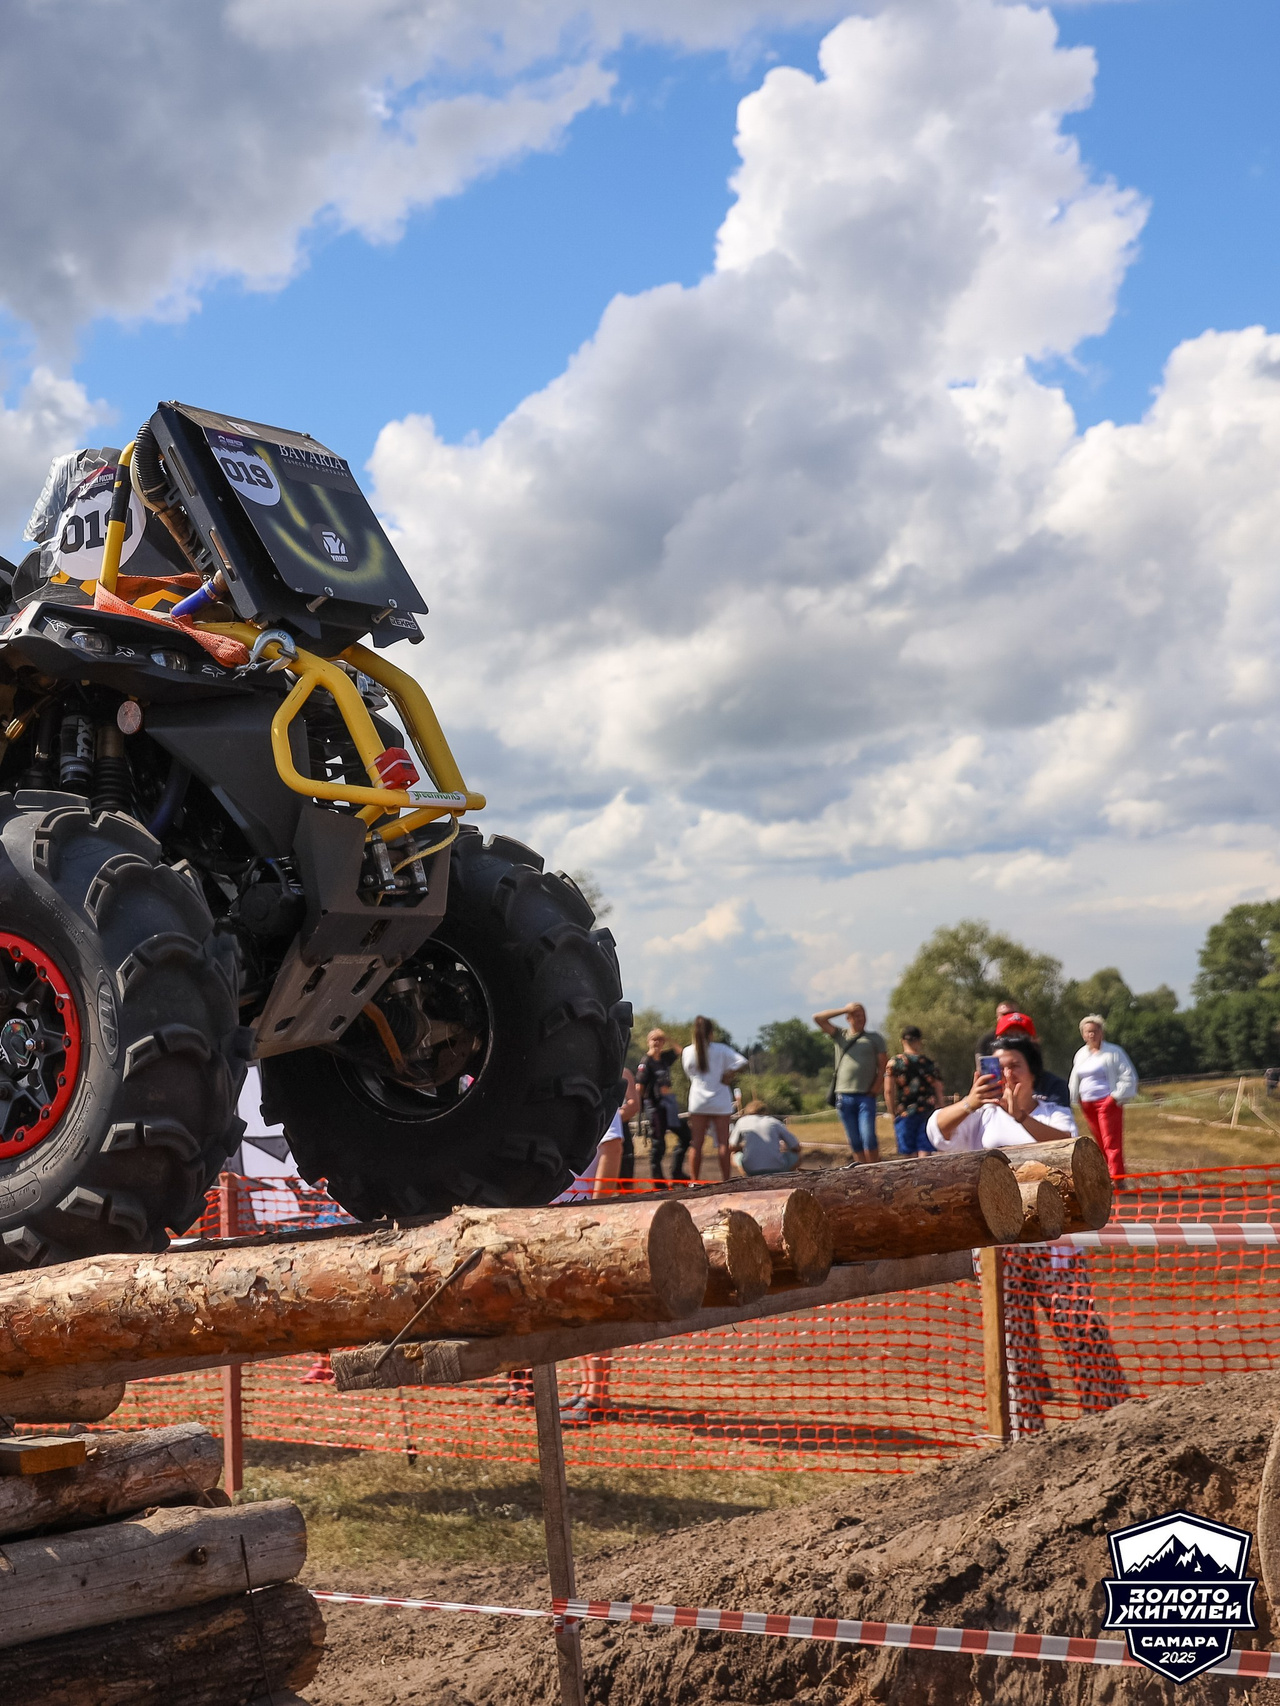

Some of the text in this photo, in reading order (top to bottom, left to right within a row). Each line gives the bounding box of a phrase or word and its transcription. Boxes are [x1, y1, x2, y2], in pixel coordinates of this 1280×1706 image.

[219, 456, 274, 490] 019
[278, 444, 346, 471] BAVARIA
[76, 717, 94, 759] FOX
